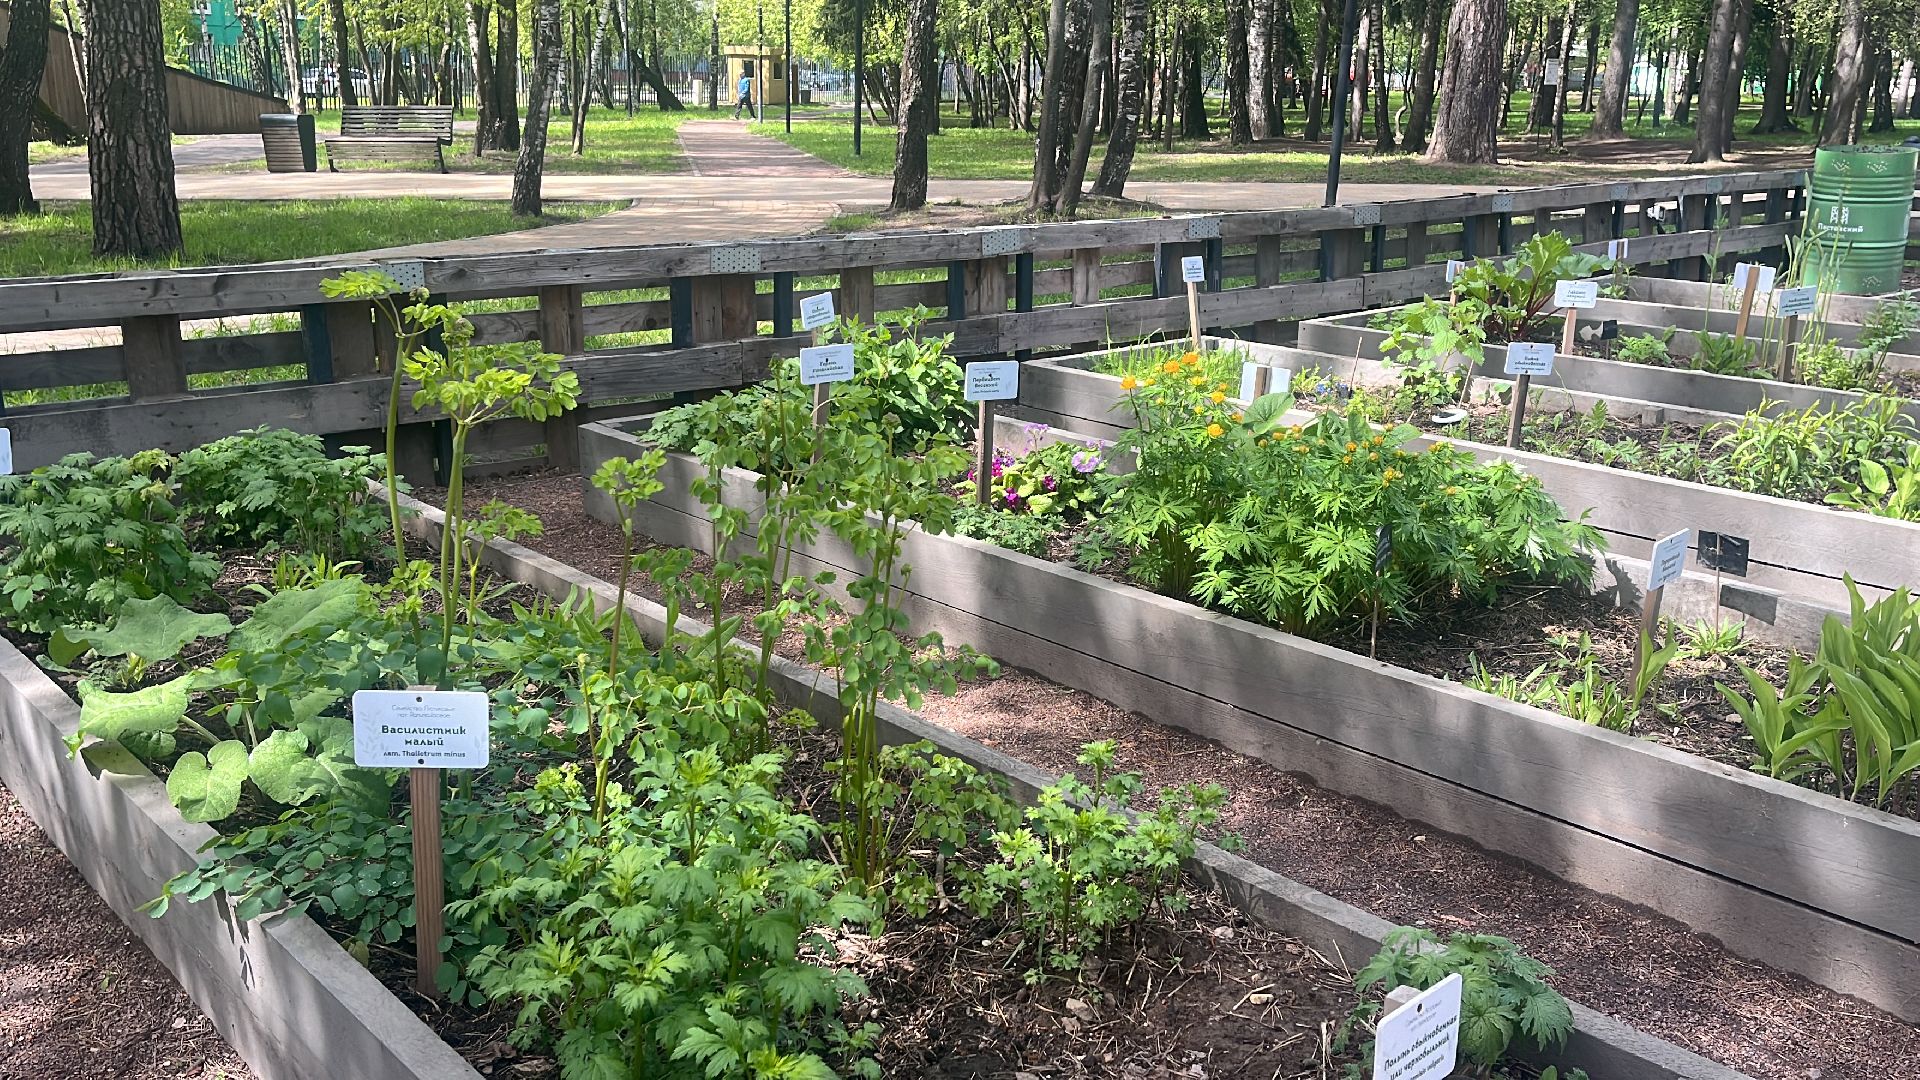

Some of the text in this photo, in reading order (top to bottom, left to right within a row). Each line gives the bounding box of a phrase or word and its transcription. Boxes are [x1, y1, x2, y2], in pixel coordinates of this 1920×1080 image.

[381, 724, 466, 735] Василистник
[404, 737, 444, 746] малый
[1384, 1048, 1411, 1071] Полынь
[1411, 1015, 1457, 1052] обыкновенная
[1390, 1032, 1450, 1080] или чернобыльник
